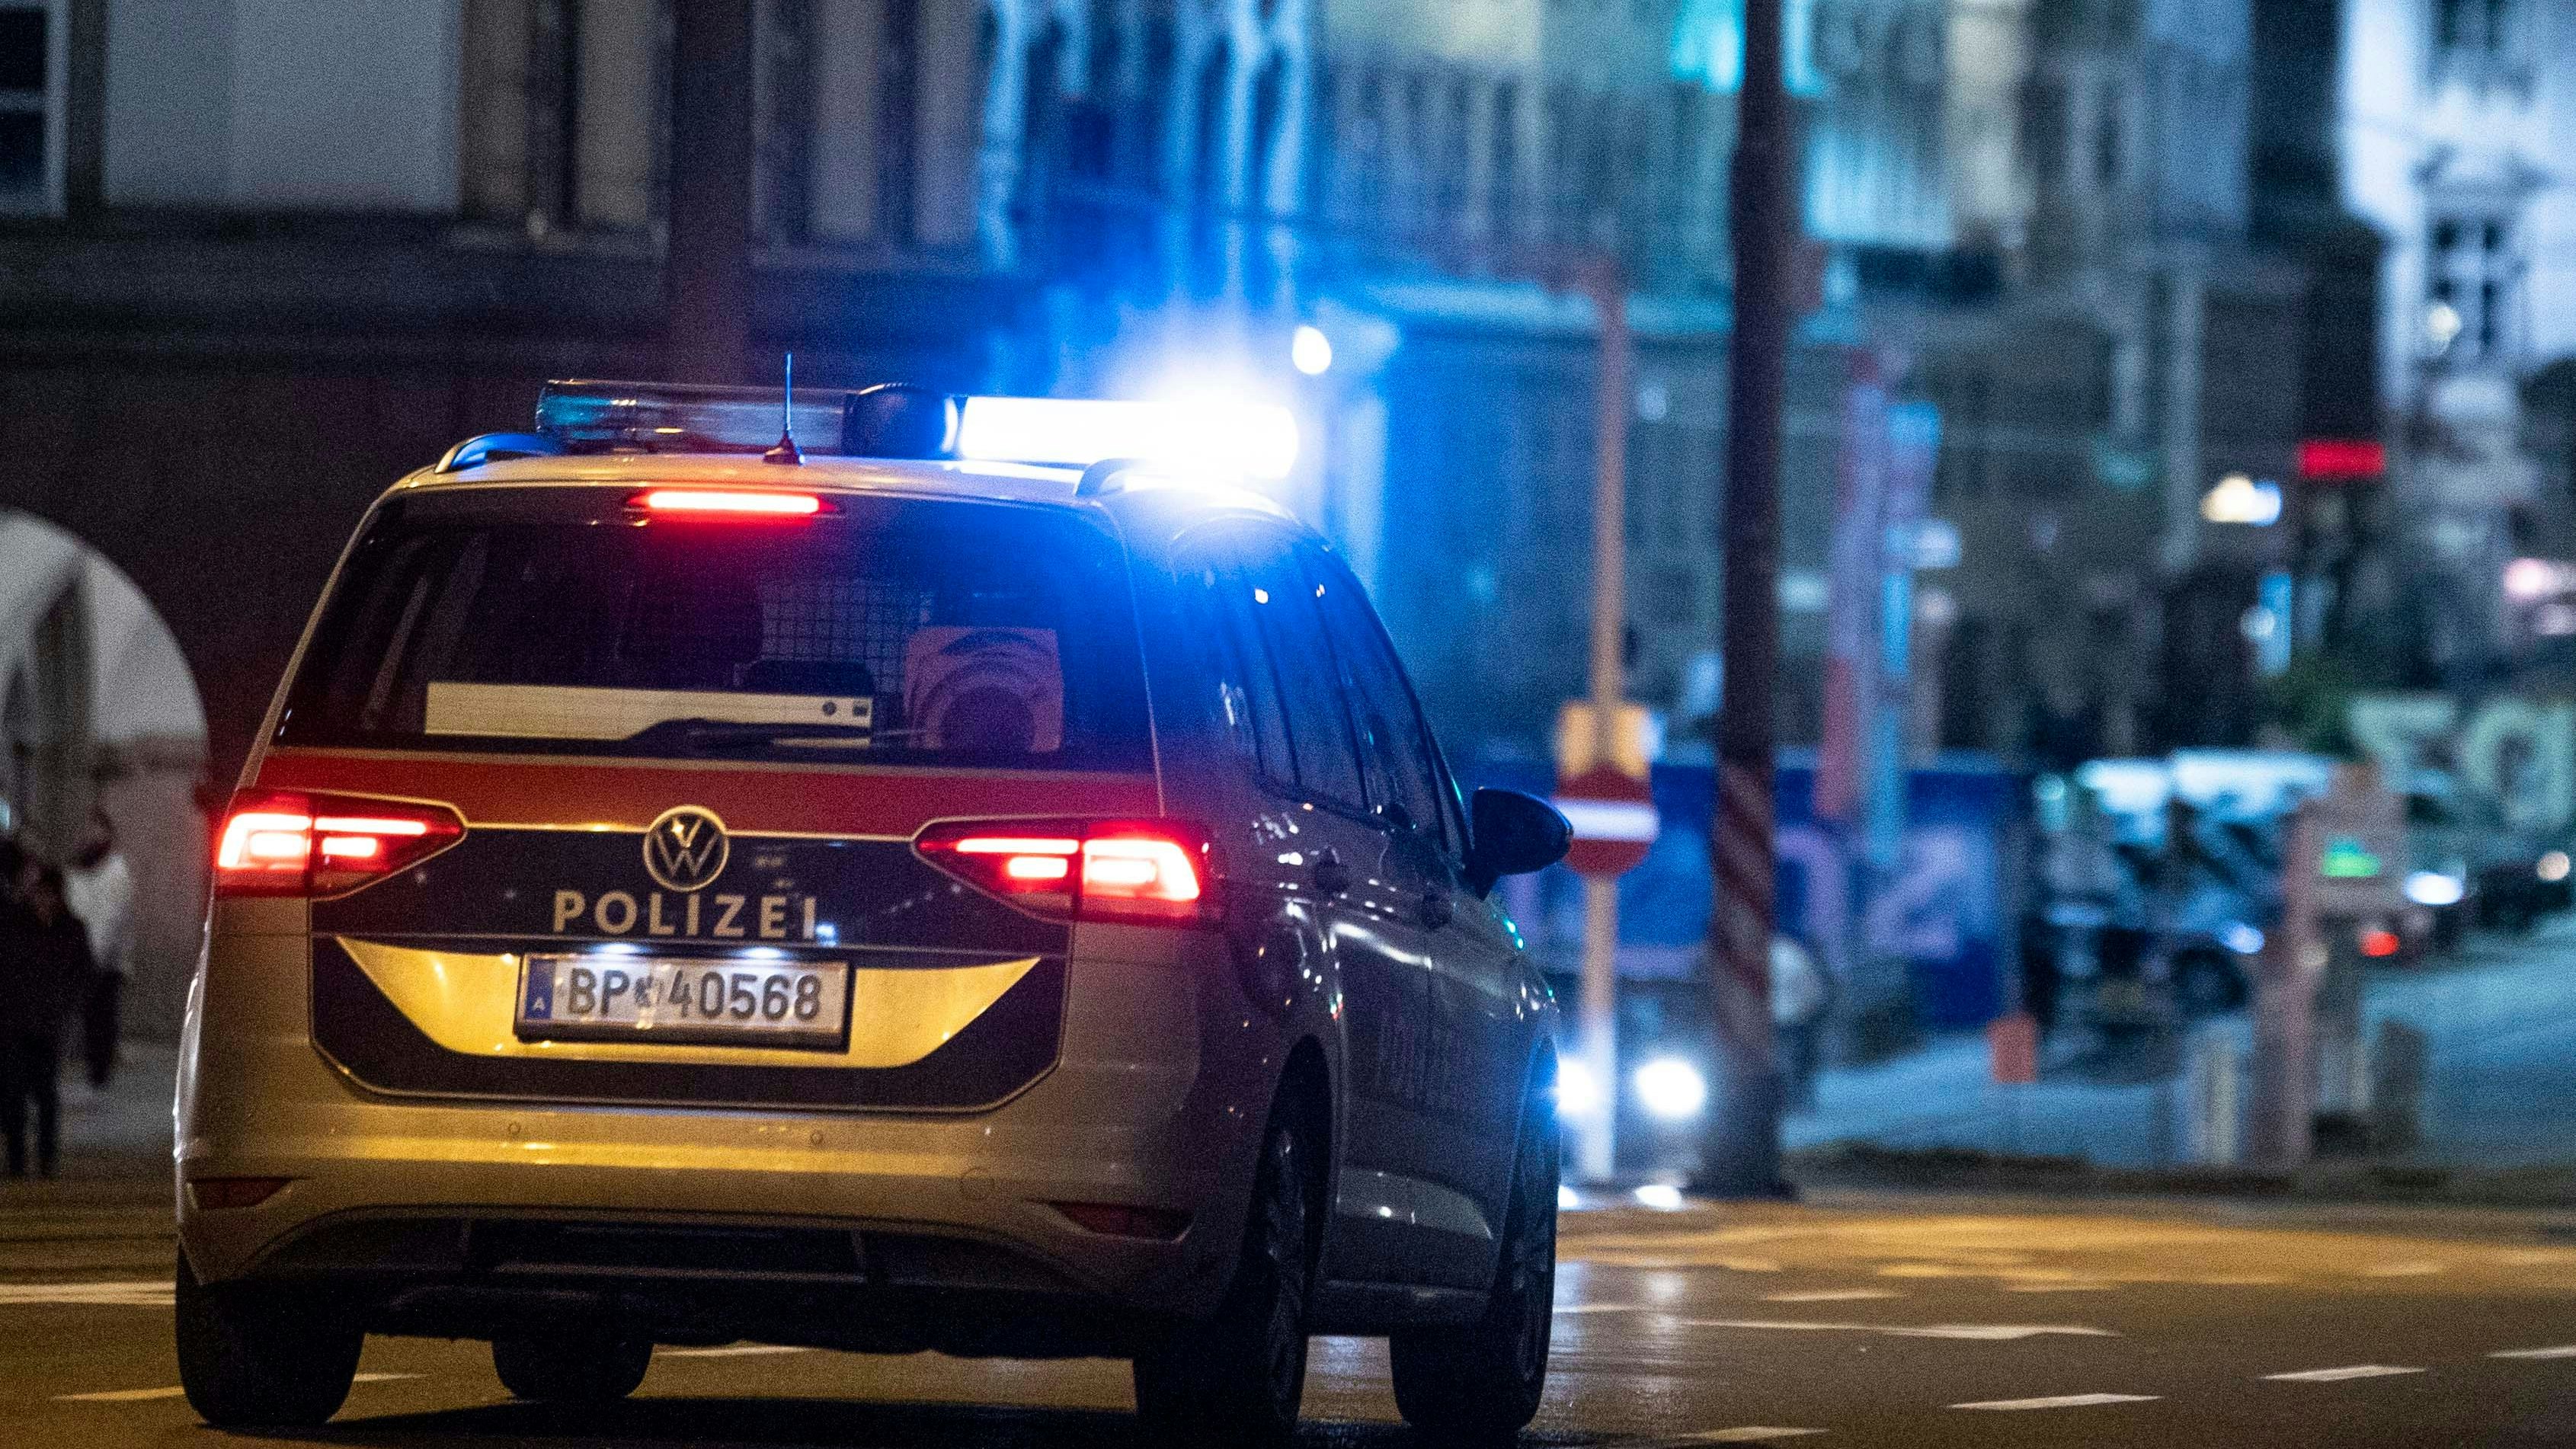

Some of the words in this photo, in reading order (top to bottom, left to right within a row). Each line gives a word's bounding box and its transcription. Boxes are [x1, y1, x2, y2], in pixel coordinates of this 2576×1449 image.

[648, 808, 725, 885] VW
[553, 890, 817, 939] POLIZEI
[533, 996, 546, 1012] A
[568, 968, 630, 1017] BP
[667, 970, 821, 1022] 40568
